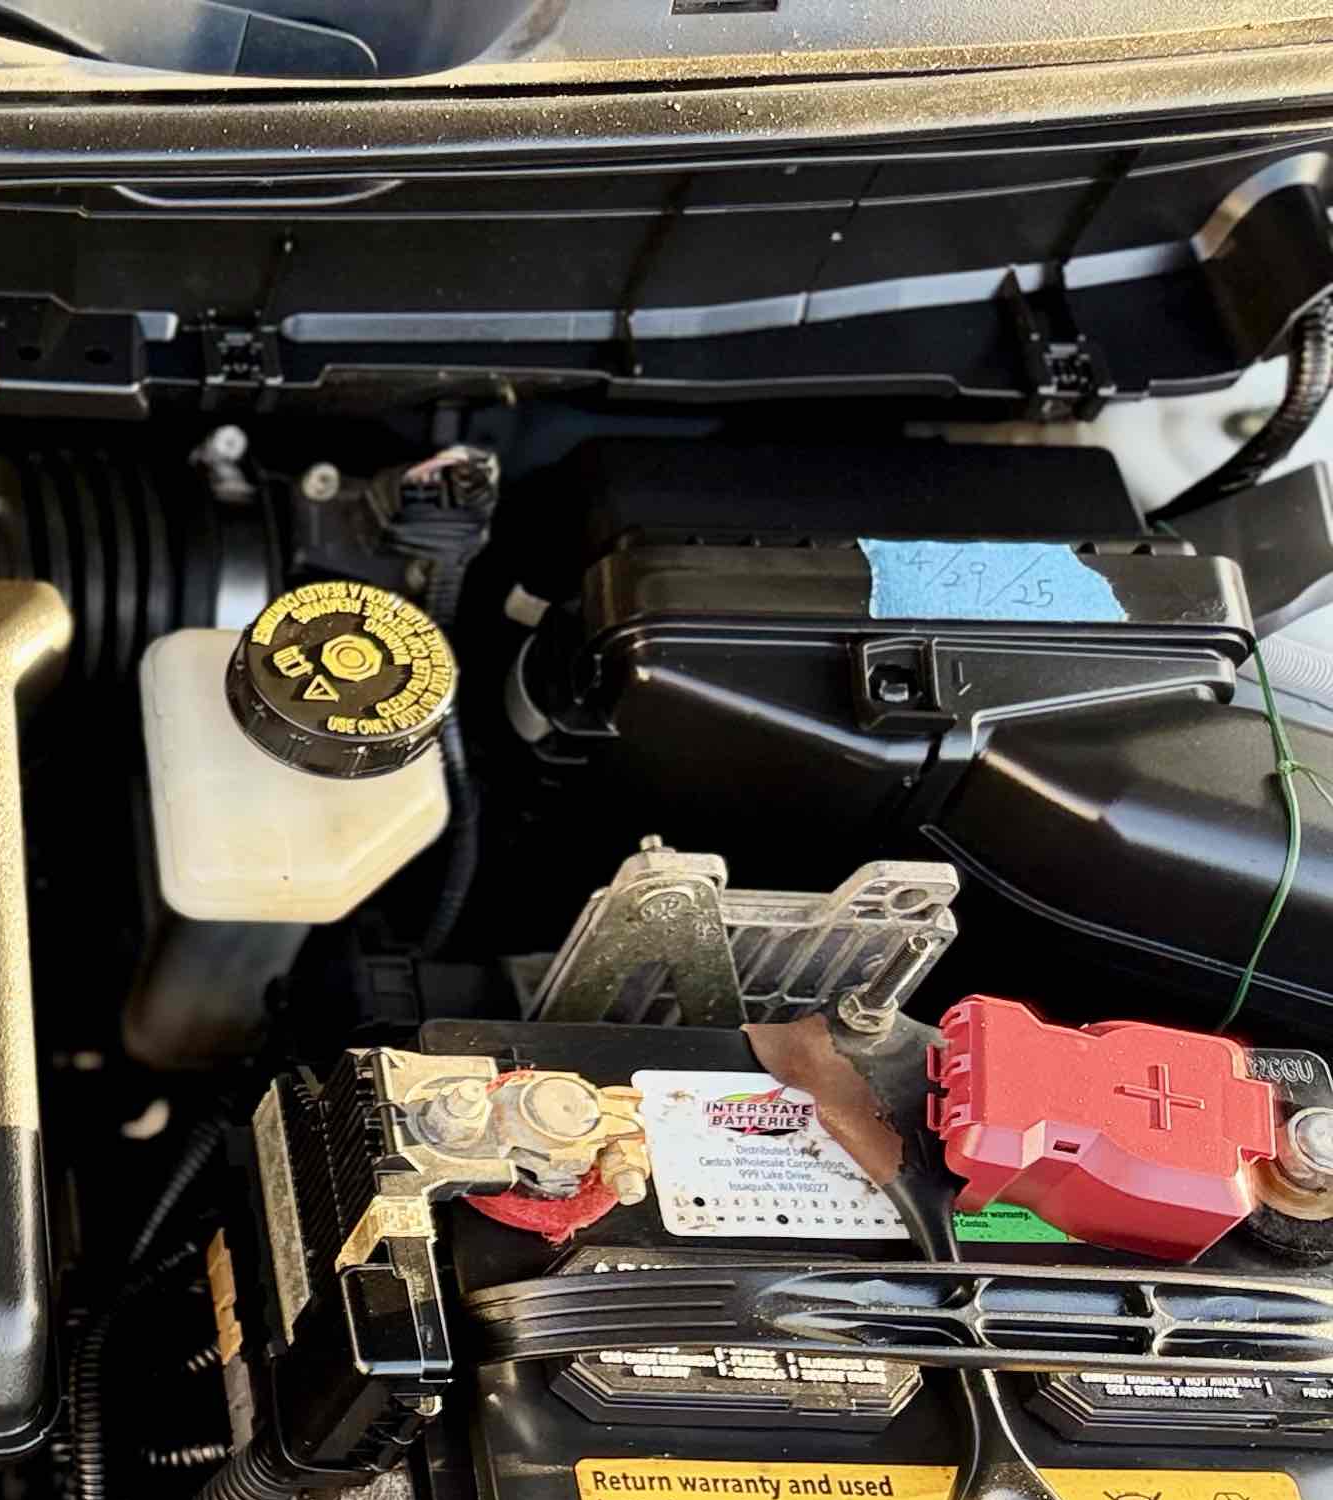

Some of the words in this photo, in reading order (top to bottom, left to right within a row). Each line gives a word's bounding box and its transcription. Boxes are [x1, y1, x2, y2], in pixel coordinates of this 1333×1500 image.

[705, 1102, 814, 1116] INTERSTATE
[712, 1114, 809, 1128] BATTERIES
[592, 1471, 672, 1491] Return
[677, 1475, 781, 1500] warranty
[788, 1474, 833, 1495] and
[837, 1476, 894, 1497] used
